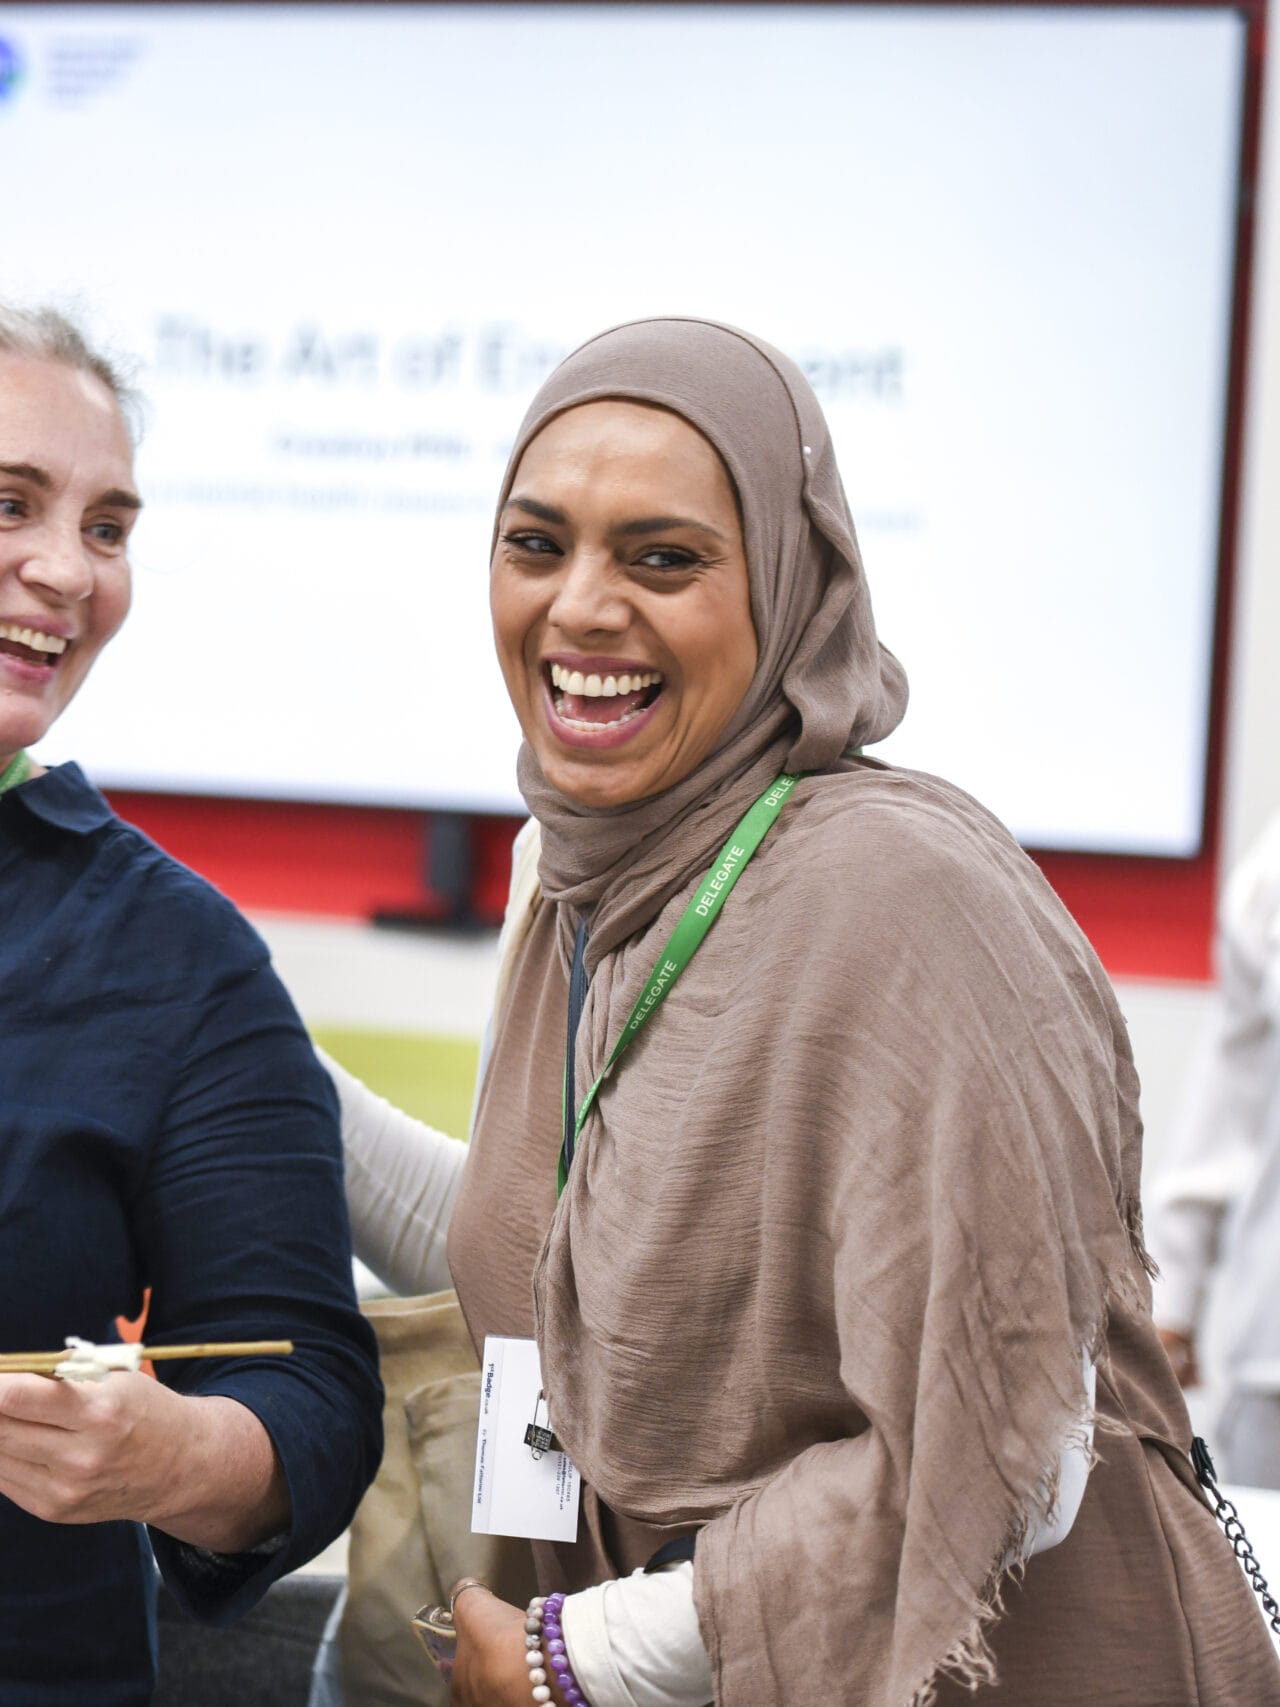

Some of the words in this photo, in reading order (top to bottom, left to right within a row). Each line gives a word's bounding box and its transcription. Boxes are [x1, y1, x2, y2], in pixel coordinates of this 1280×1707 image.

[156, 316, 261, 383] The
[284, 319, 380, 385] Art
[396, 325, 463, 388] of
[695, 845, 745, 917] DELEGATE
[629, 959, 677, 1031] DELEGATE
